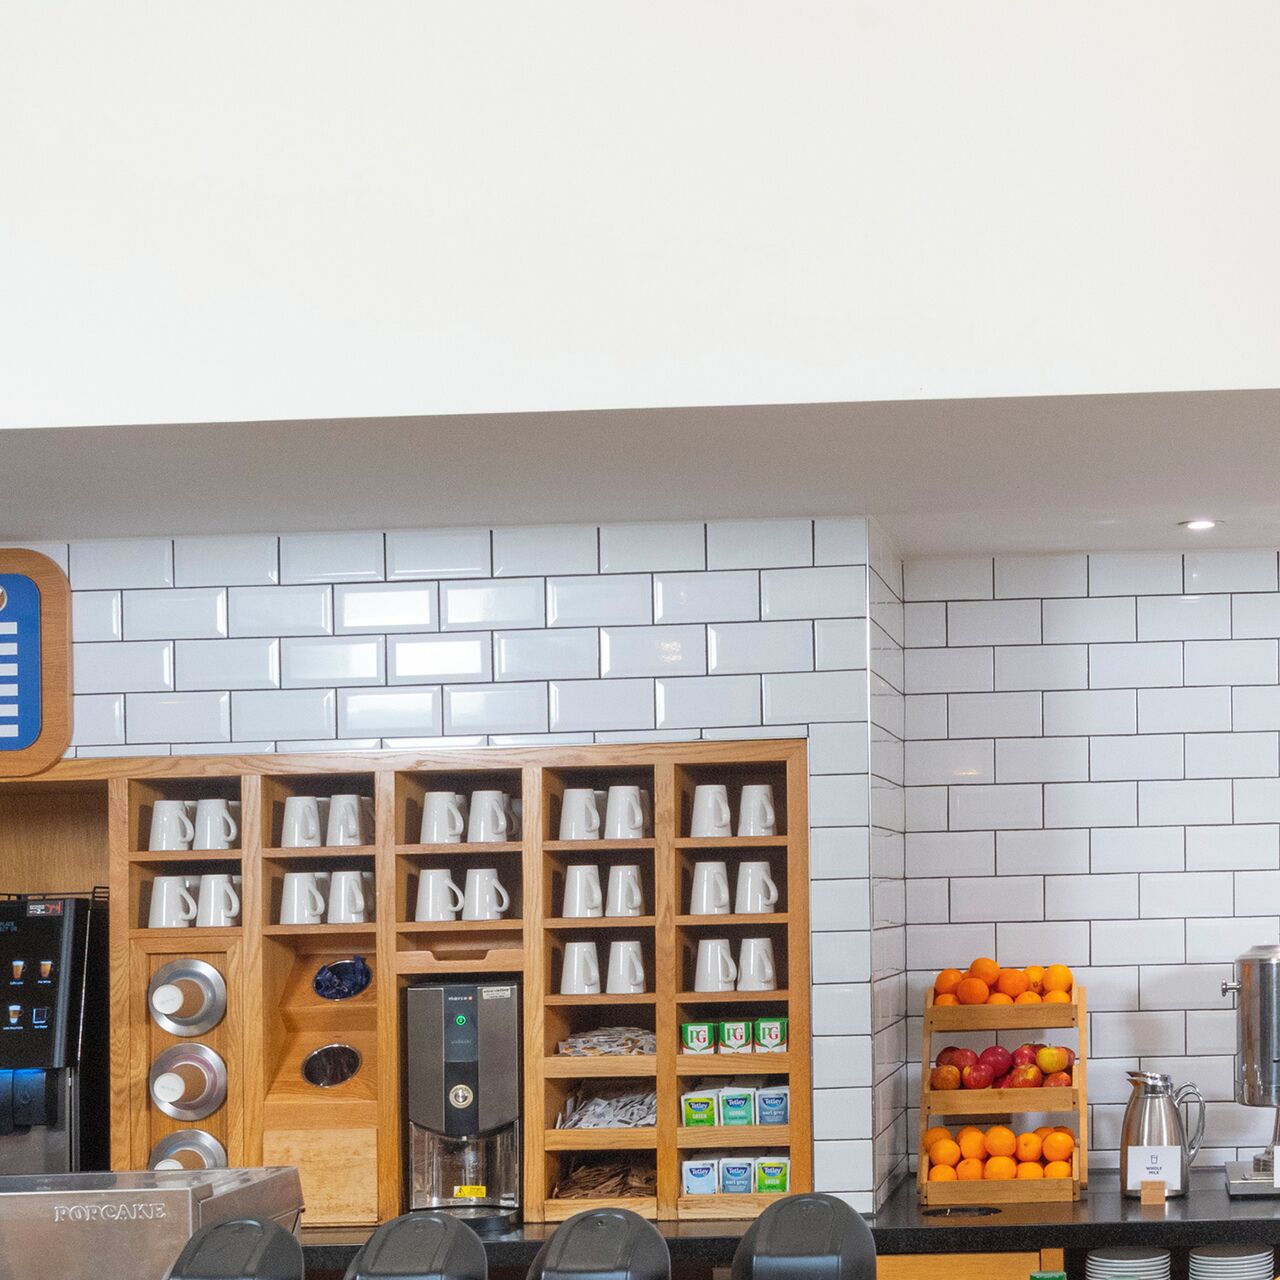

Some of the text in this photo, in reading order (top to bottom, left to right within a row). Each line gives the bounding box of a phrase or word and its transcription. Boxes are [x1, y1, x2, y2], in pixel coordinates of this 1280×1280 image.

[689, 1029, 707, 1043] PG
[726, 1026, 743, 1041] PG
[762, 1026, 779, 1040] PG
[691, 1102, 708, 1110] Tetley
[54, 1203, 166, 1222] POPCAKE
